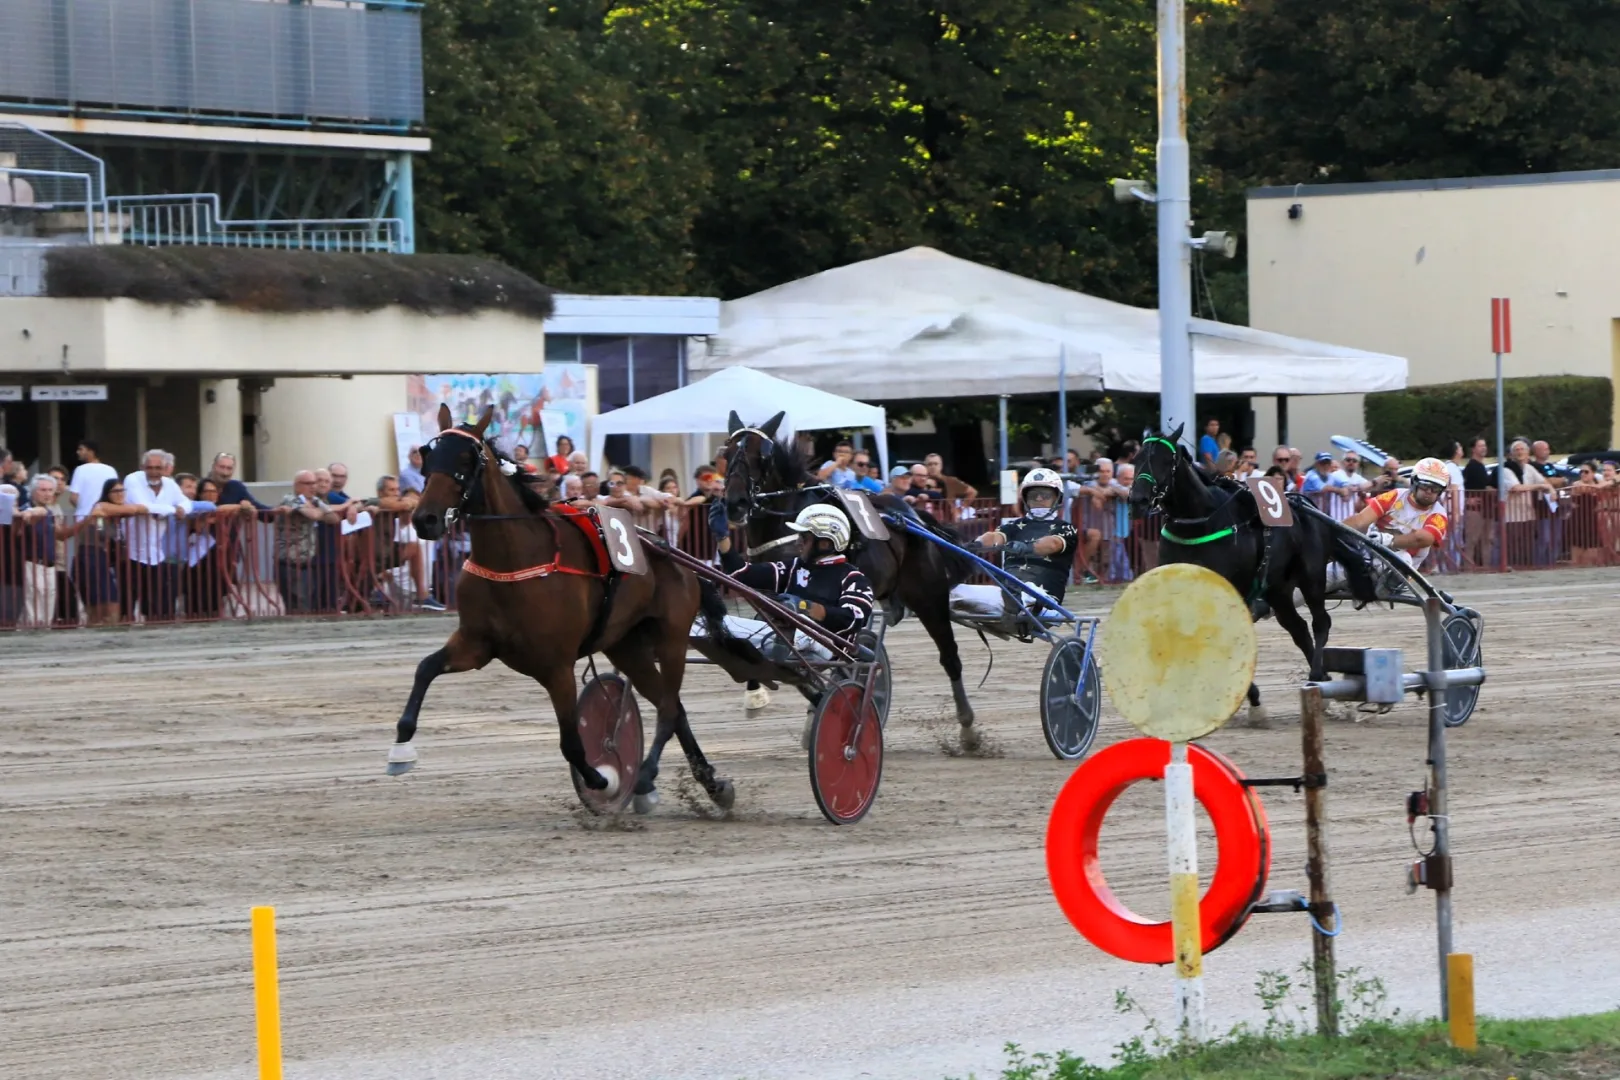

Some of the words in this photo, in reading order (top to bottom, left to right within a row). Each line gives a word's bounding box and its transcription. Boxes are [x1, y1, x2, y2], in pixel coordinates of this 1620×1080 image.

[843, 493, 875, 533] 7
[1257, 480, 1283, 519] 9
[609, 517, 634, 567] 3
